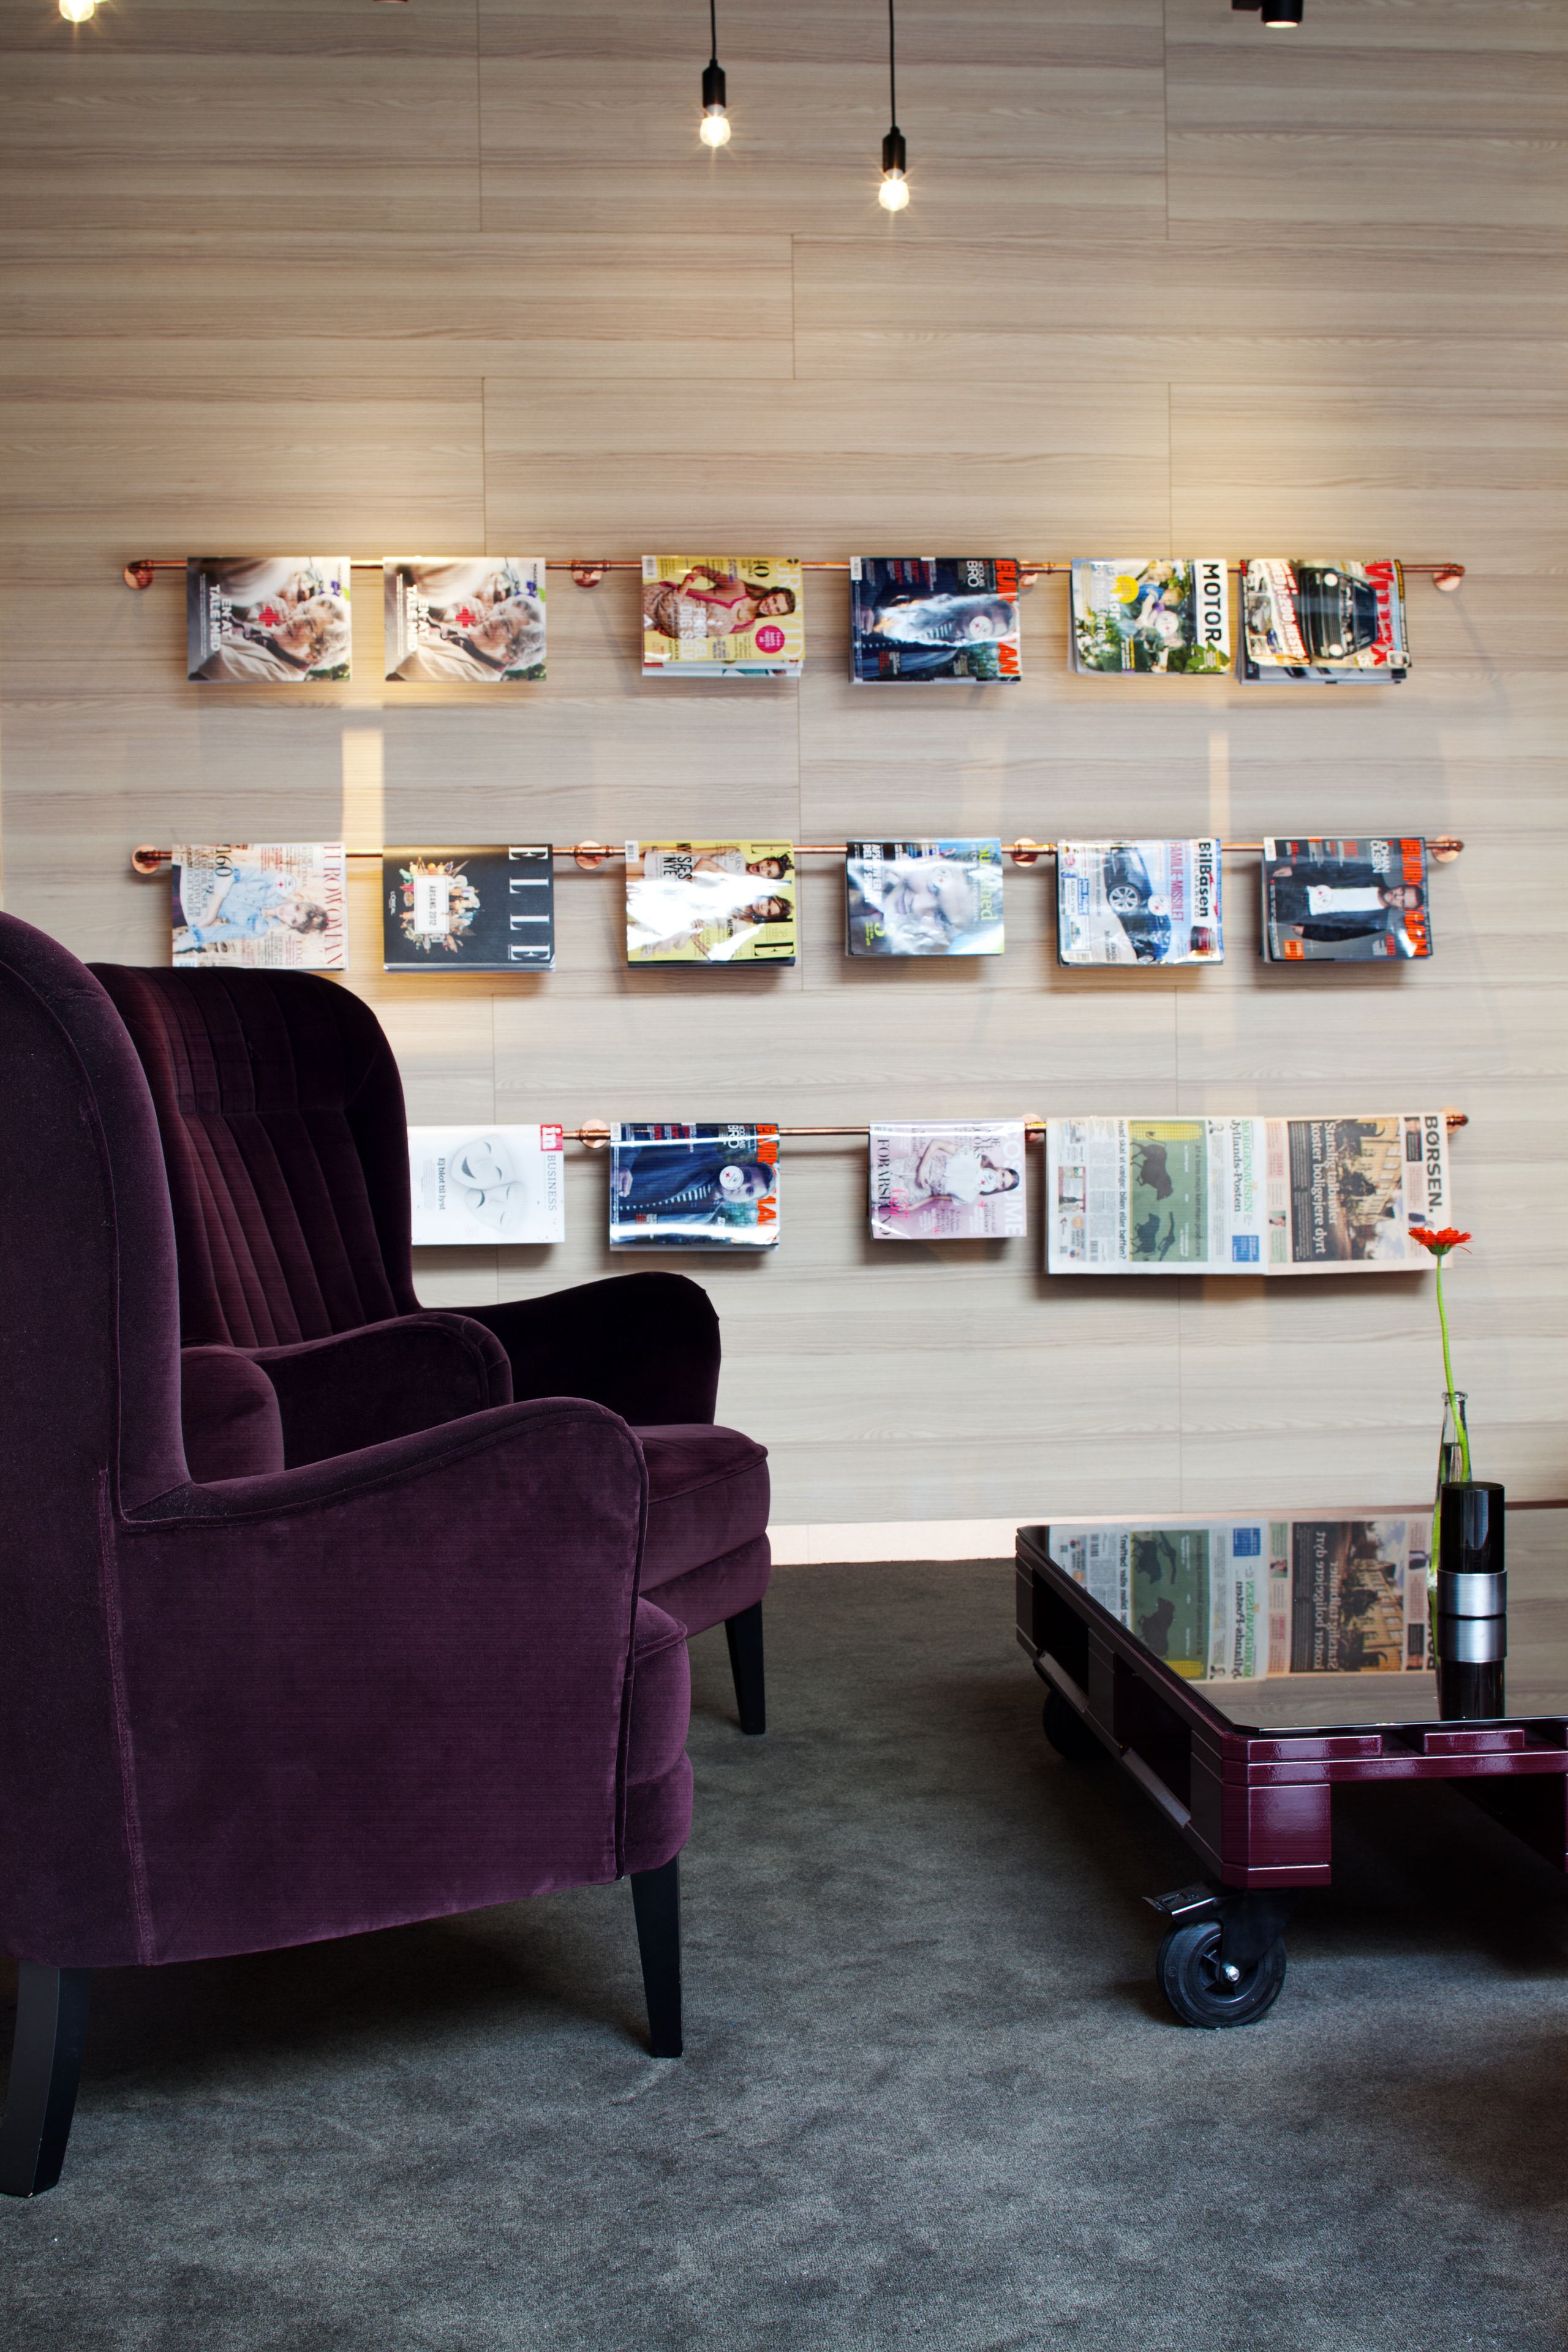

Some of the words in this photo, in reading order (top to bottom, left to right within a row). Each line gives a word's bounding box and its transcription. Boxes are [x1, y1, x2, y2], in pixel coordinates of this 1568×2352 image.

[966, 560, 979, 587] BRO
[209, 584, 221, 619] TALE
[222, 598, 232, 617] EN
[407, 585, 418, 619] TALE
[418, 599, 429, 617] EN
[679, 606, 693, 629] DIG
[1203, 564, 1222, 642] MOTOR
[209, 622, 221, 651] MED
[222, 619, 232, 637] AT
[407, 622, 418, 652] MED
[418, 620, 429, 638] AT
[695, 608, 707, 658] FORKÆL
[680, 631, 694, 660] SELV
[215, 848, 233, 876] 160
[1370, 840, 1382, 873] OLSEN
[1381, 840, 1390, 873] JOHAN
[1170, 843, 1184, 921] FAMILIE-MISSILET
[1199, 842, 1213, 917] BilBasen
[323, 846, 343, 964] EUROWOMAN
[508, 846, 551, 960] ELLE
[542, 1127, 561, 1149] in
[728, 1125, 739, 1149] BRO
[1310, 1123, 1323, 1160] koster
[1324, 1122, 1338, 1169] Statslig
[1230, 1120, 1243, 1212] Jyllands-Posten
[1242, 1120, 1253, 1212] MORGENAVISEN
[548, 1155, 557, 1211] BUSINESS
[1311, 1163, 1325, 1226] boligejere
[1327, 1171, 1340, 1226] talbrøler
[437, 1195, 446, 1210] lyst
[1312, 1228, 1327, 1254] dyrt
